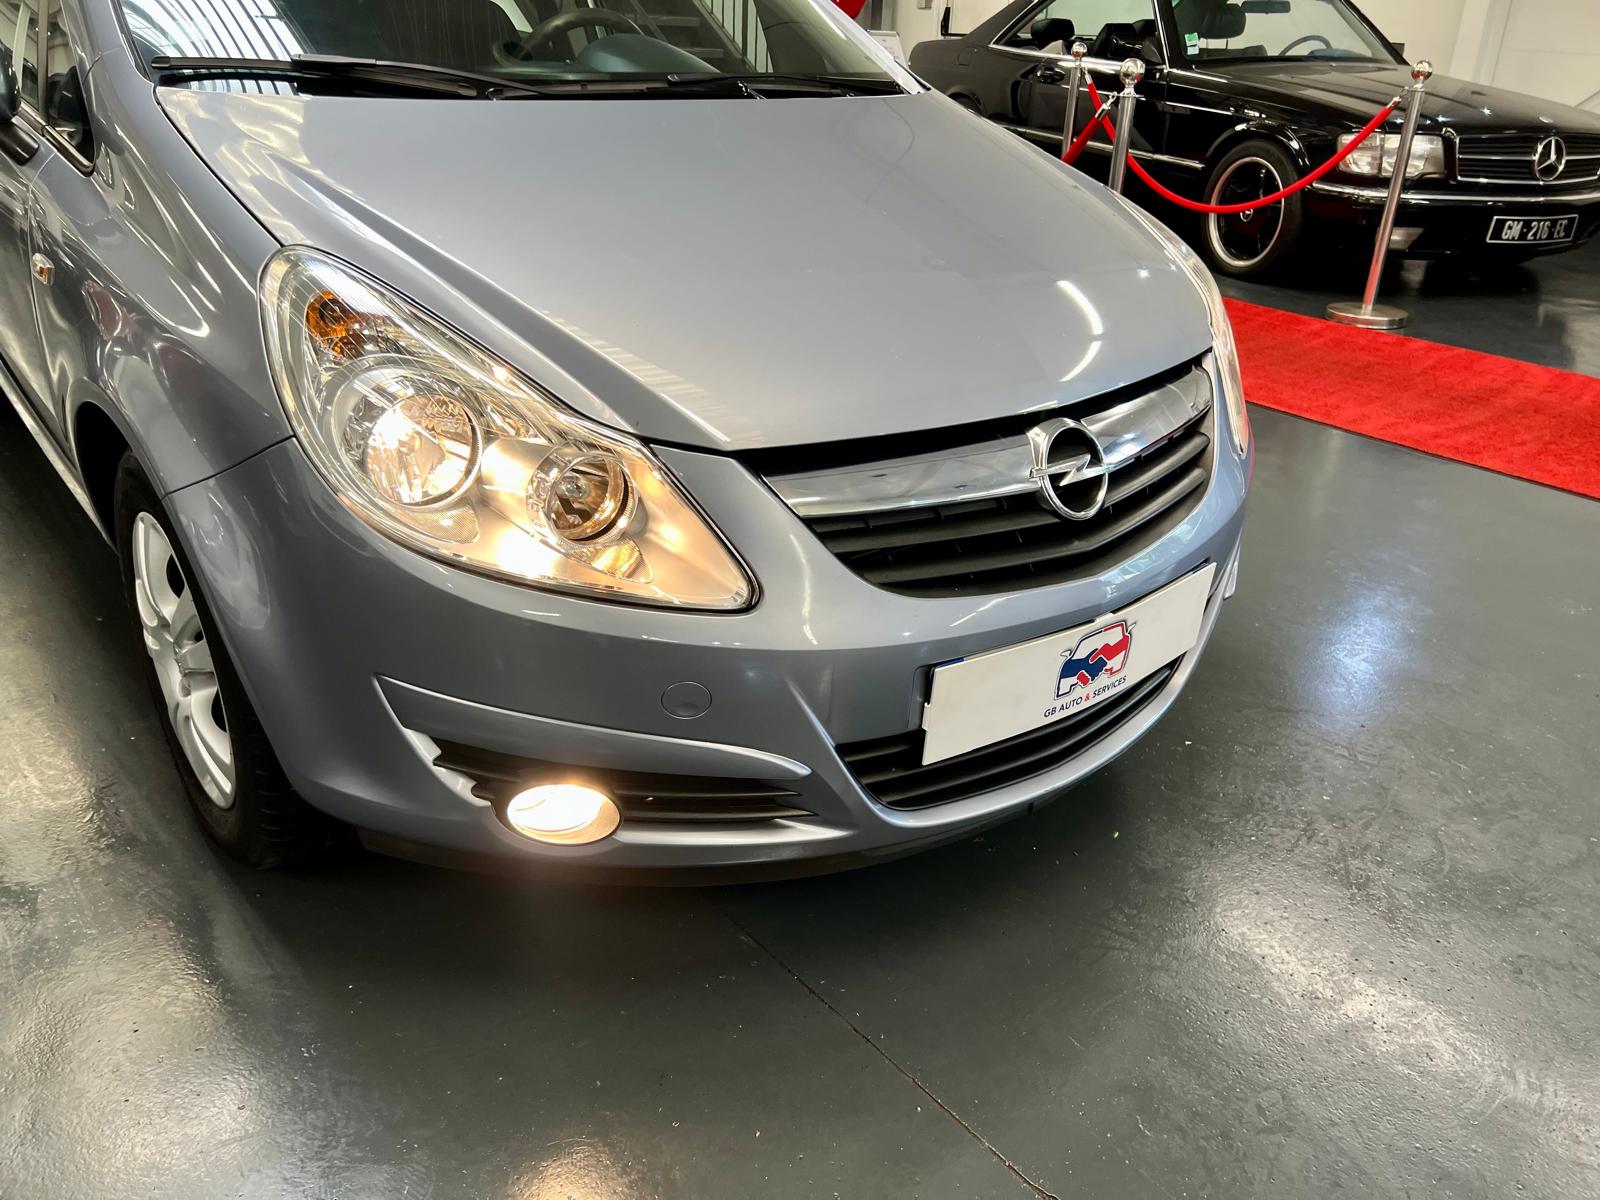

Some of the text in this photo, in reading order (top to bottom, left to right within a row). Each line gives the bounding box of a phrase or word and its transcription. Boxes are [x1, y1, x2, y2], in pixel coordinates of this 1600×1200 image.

[1044, 675, 1127, 718] GB AUTO & SERVICES
